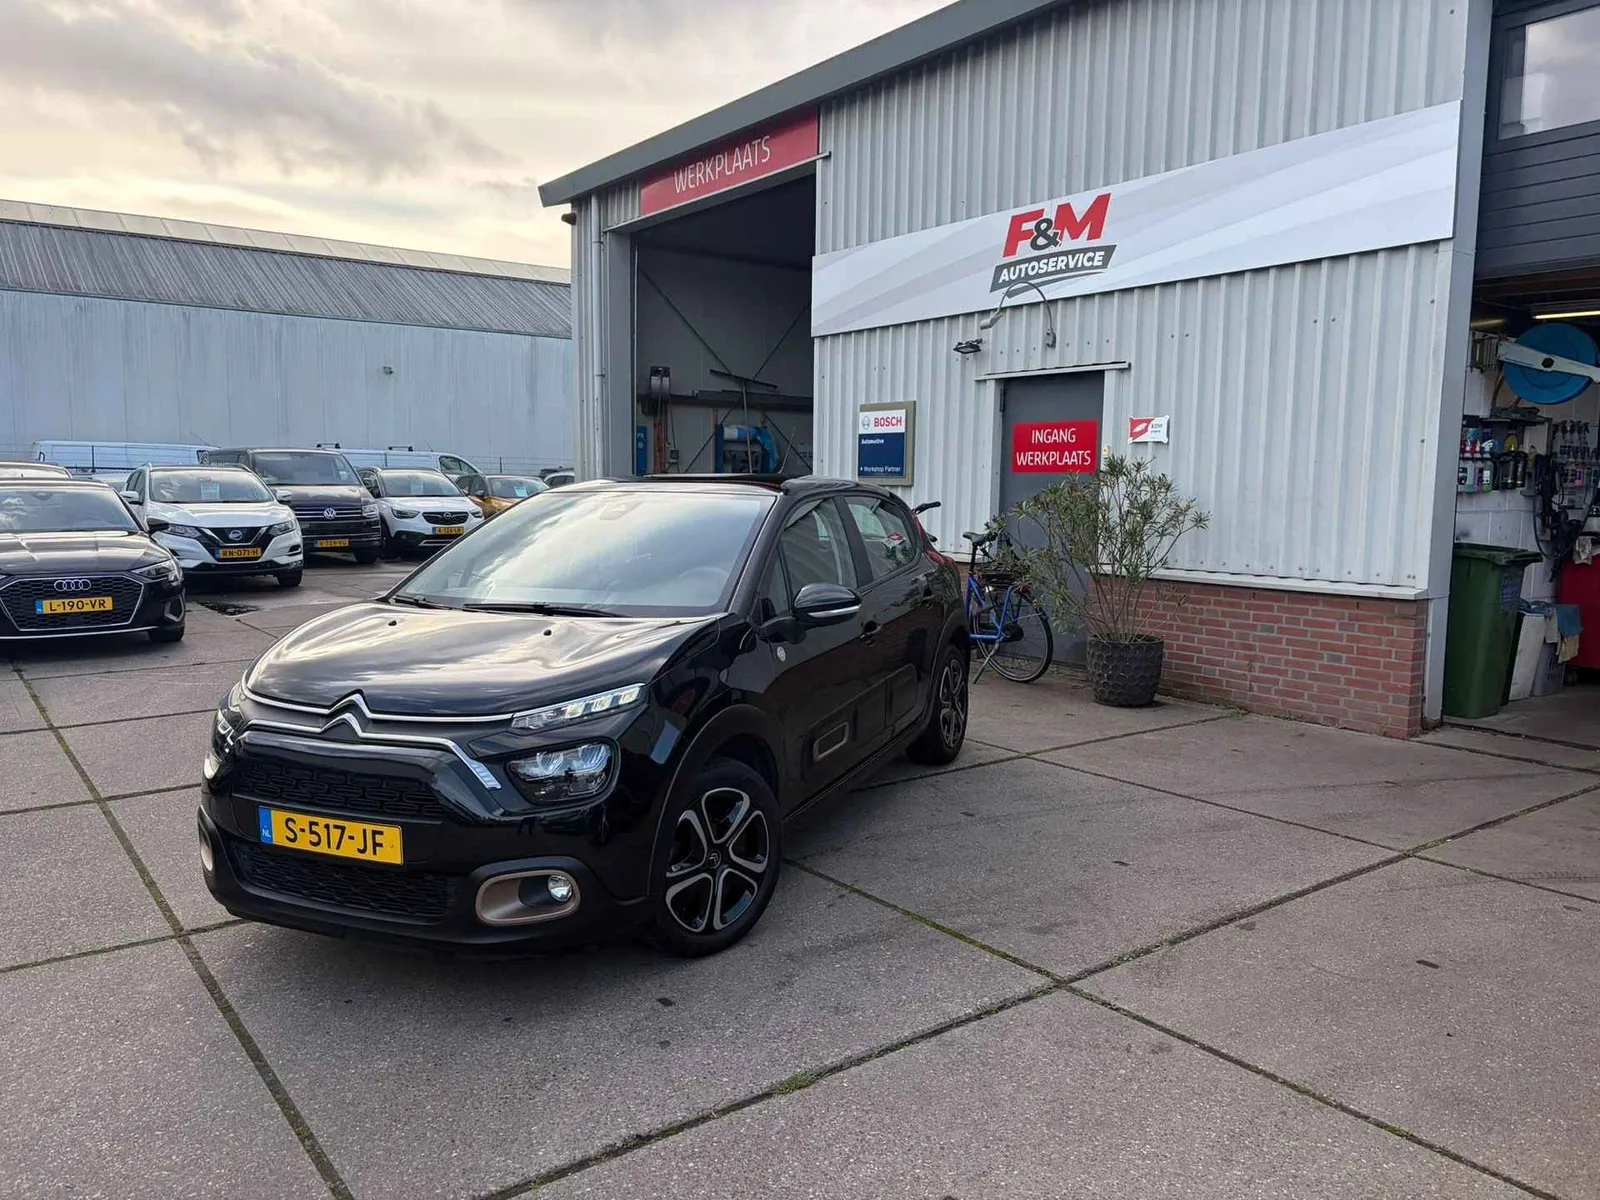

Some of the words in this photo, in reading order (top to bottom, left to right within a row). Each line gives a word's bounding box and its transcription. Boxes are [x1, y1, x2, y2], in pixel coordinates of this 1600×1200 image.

[674, 135, 771, 194] WERKPLAATS
[1002, 192, 1111, 258] F&M
[998, 251, 1105, 283] AUTOSERVICE
[873, 416, 902, 427] BOSCH
[1031, 428, 1077, 444] INGANG
[1016, 450, 1092, 466] WERKPLAATS
[222, 548, 259, 558] RN-071-H
[49, 599, 107, 611] L-190-VR
[284, 817, 384, 856] S-517-JF
